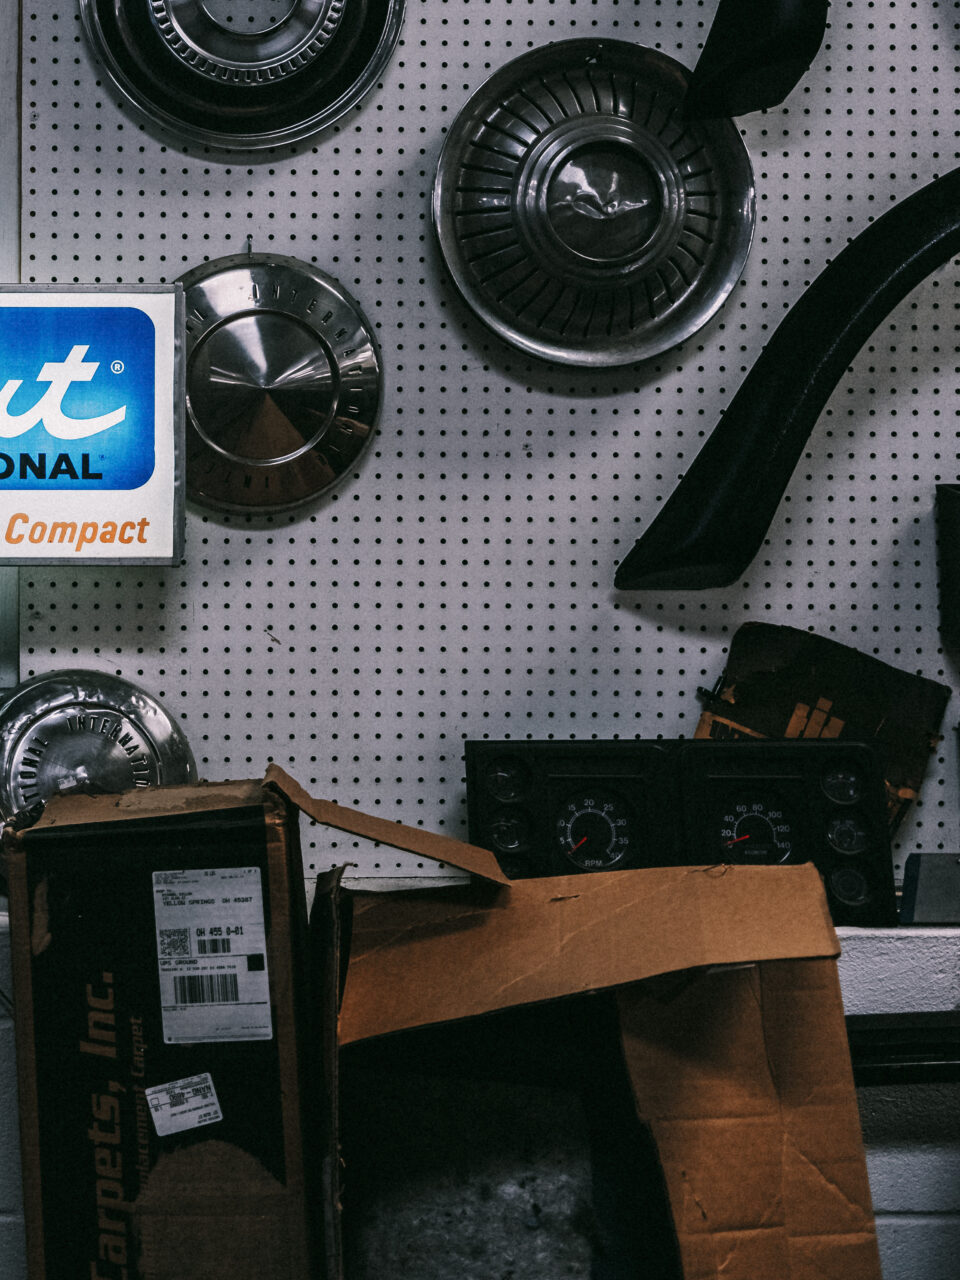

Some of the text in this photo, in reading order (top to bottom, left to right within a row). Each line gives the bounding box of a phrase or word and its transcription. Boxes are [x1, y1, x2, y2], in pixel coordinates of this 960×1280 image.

[4, 512, 150, 552] Compact
[66, 715, 151, 788] INTERNATIO
[721, 829, 731, 837] 20
[196, 928, 205, 937] OH
[128, 1015, 148, 1079] Carpet
[79, 970, 137, 1280] Carpets, Inc.
